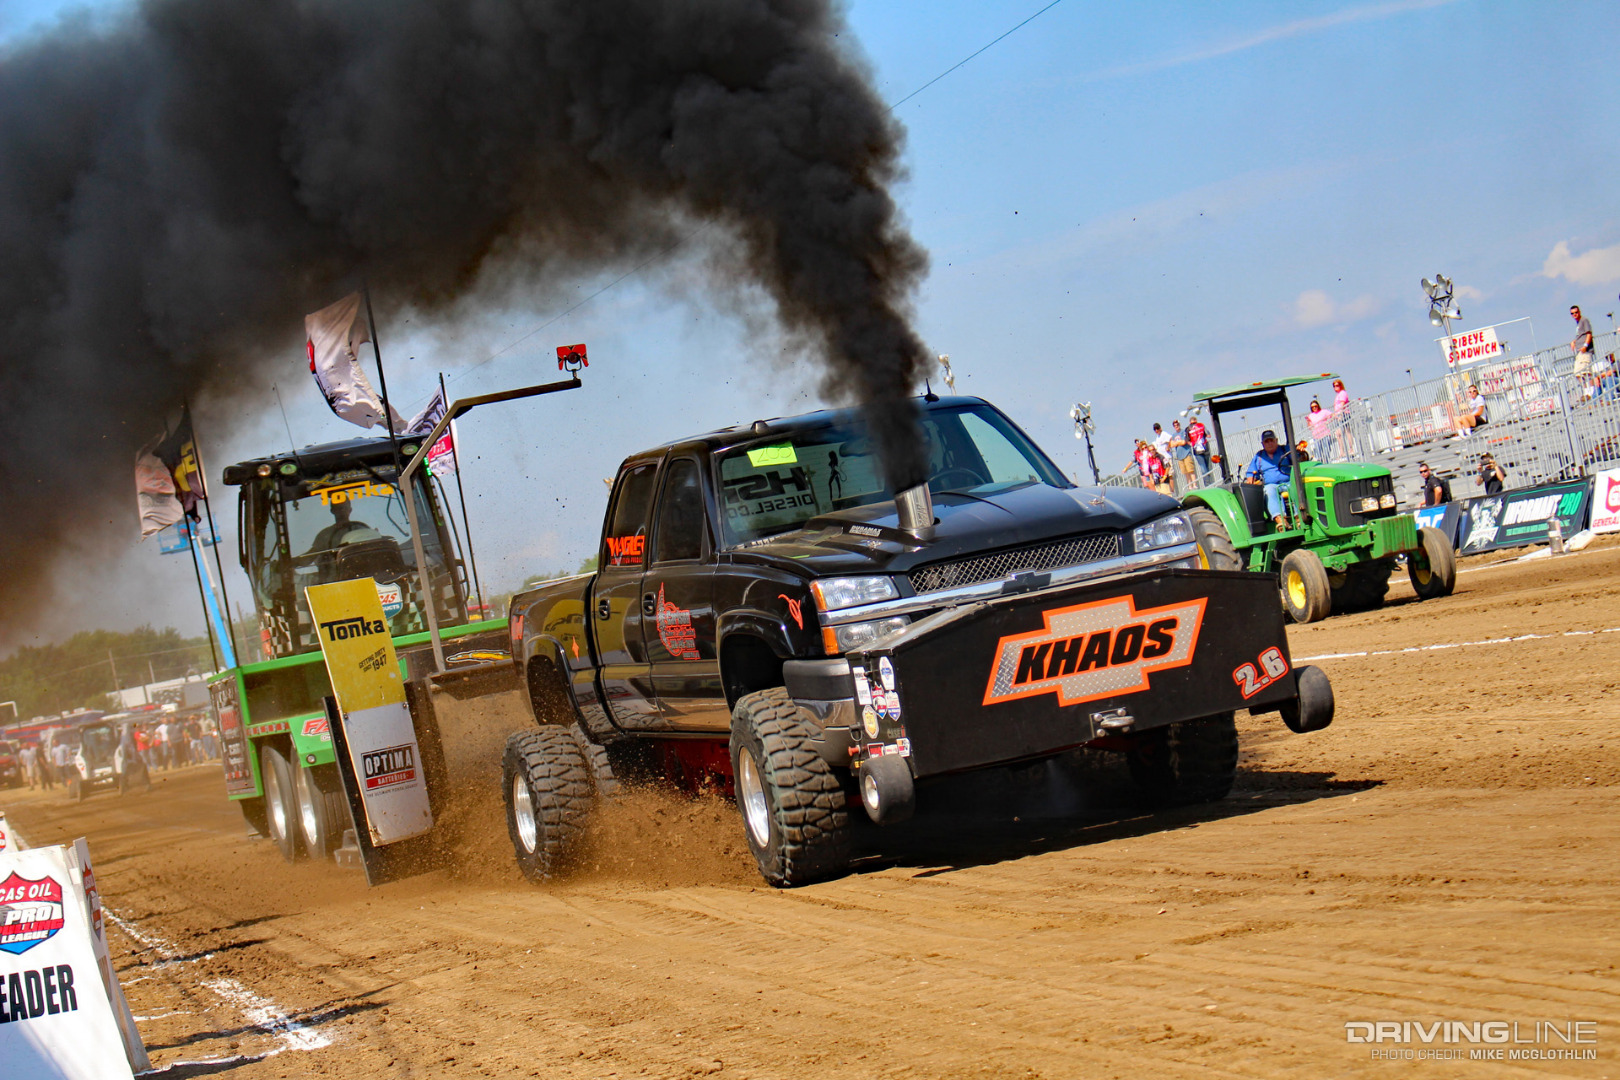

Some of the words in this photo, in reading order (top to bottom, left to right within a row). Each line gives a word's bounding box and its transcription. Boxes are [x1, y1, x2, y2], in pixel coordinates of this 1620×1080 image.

[1452, 331, 1484, 349] RIBEYE
[1449, 342, 1498, 363] SANDWICH
[310, 480, 395, 506] Tonka
[1557, 491, 1583, 516] PRO
[320, 616, 385, 641] Tonka
[372, 654, 387, 671] 1947
[1013, 618, 1178, 686] KHAOS
[1233, 647, 1289, 699] 2.6
[365, 749, 413, 776] OPTIMA
[378, 772, 407, 785] BATTERIES
[28, 883, 53, 899] OIL
[5, 906, 53, 926] PRO
[1, 930, 49, 944] LEAGUE
